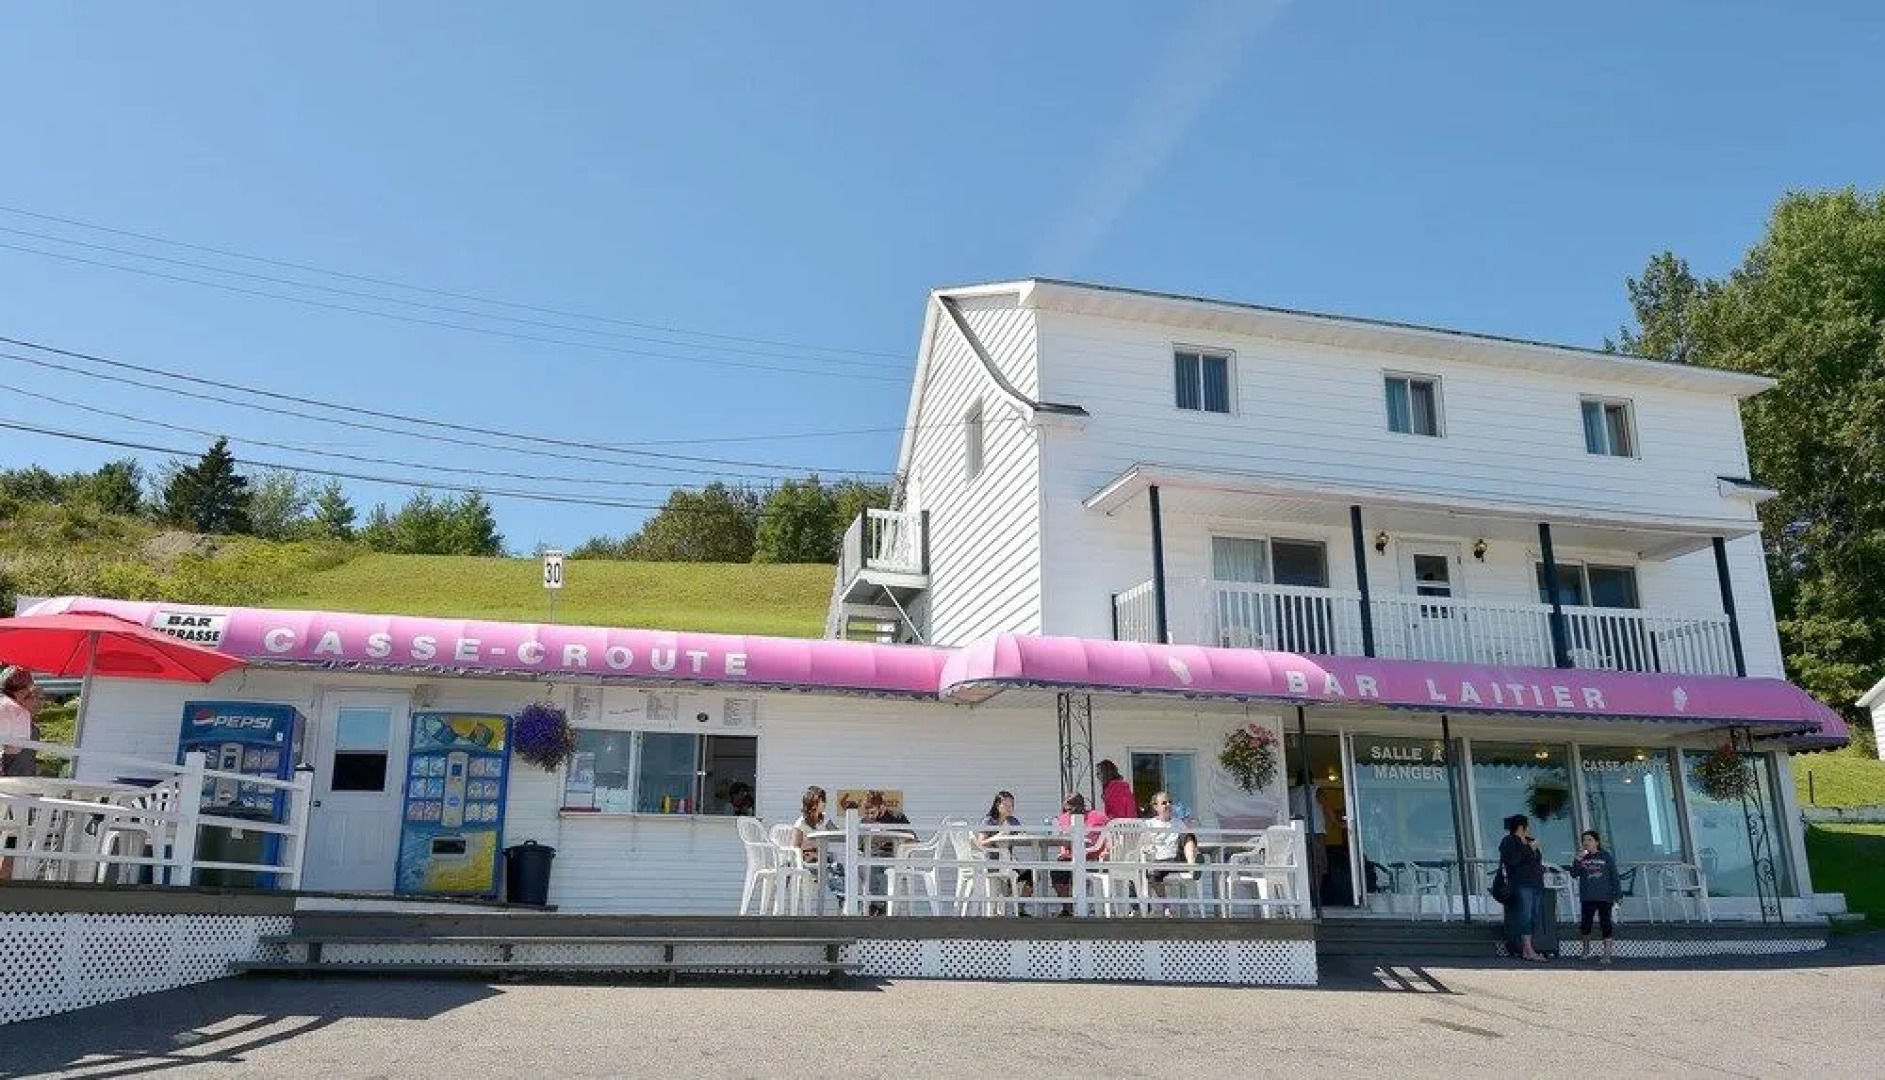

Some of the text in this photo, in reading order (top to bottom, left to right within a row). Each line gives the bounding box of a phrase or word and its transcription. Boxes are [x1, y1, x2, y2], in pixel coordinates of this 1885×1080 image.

[546, 562, 561, 584] 30
[167, 616, 212, 627] BAR
[1285, 670, 1606, 709] BAR LAITIER
[213, 715, 274, 729] PEPSI
[1371, 746, 1422, 760] SALLE
[1373, 764, 1443, 780] MANGER
